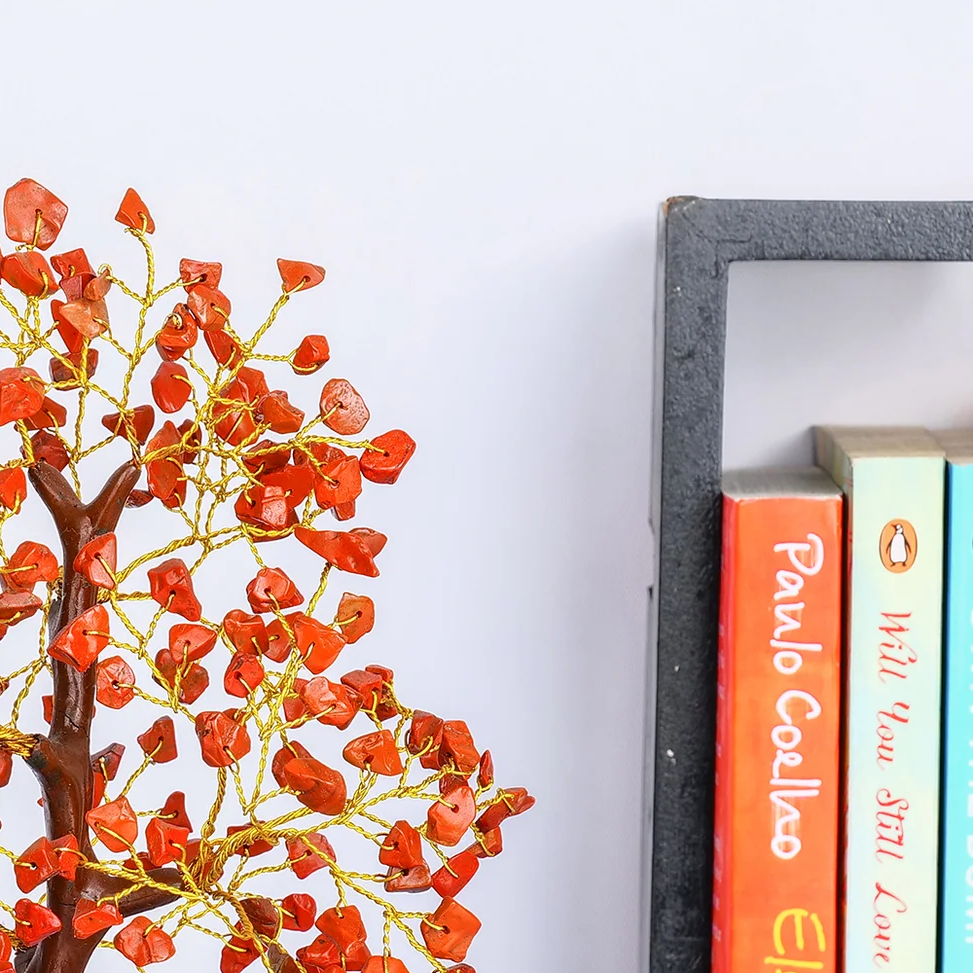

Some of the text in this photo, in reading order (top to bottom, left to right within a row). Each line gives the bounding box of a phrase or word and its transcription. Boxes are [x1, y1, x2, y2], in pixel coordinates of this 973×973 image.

[878, 611, 917, 684] Will
[768, 532, 824, 860] Paulo Coelho
[876, 702, 910, 771] You
[876, 788, 909, 864] Still
[873, 882, 907, 969] Love
